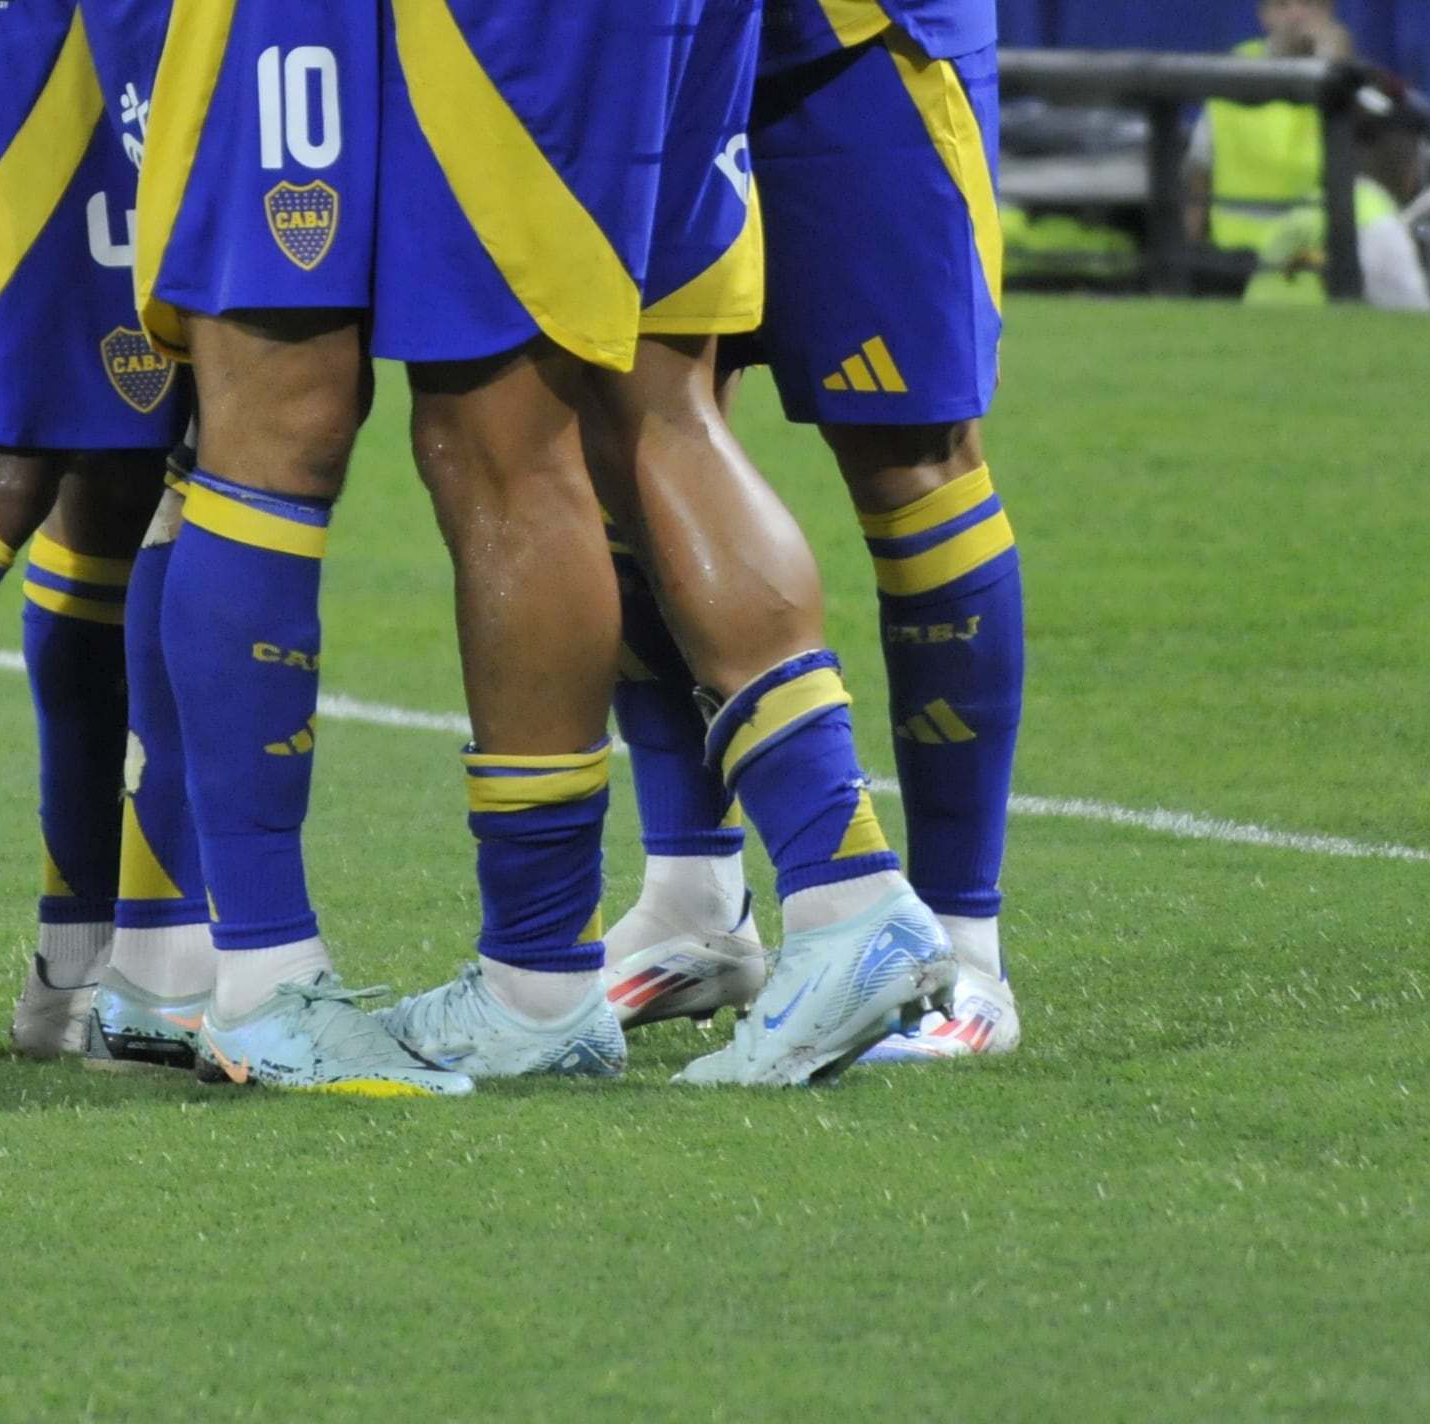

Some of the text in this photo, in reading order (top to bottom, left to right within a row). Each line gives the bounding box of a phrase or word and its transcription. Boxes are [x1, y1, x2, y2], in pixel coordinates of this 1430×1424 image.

[257, 45, 341, 169] 10
[275, 209, 329, 230] CABJ
[112, 352, 168, 374] CABJ
